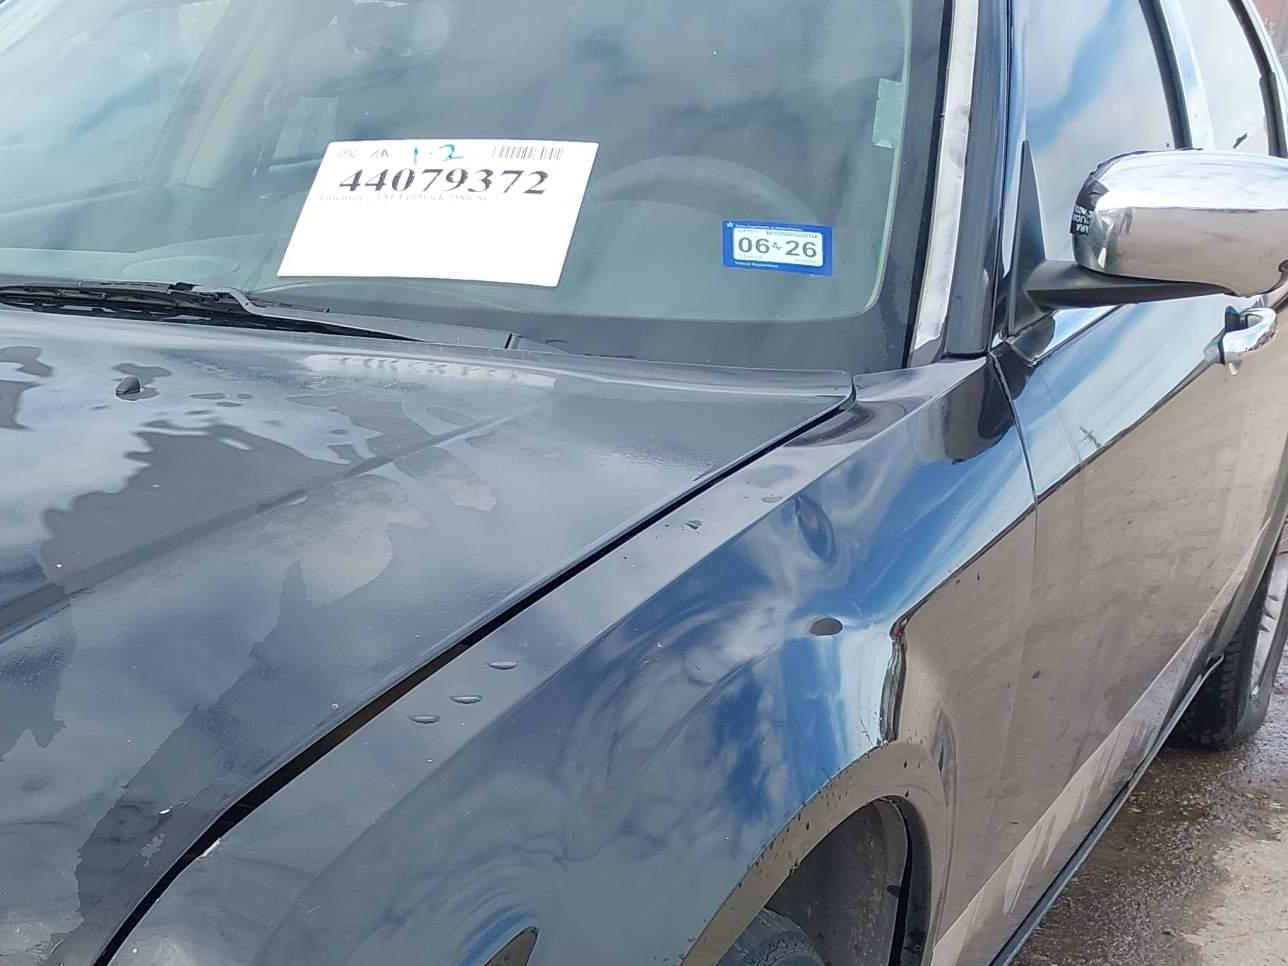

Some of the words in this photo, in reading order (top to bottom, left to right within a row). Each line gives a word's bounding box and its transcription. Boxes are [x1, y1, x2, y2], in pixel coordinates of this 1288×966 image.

[338, 167, 550, 195] 44079372
[738, 237, 770, 254] 06
[785, 240, 817, 258] 26
